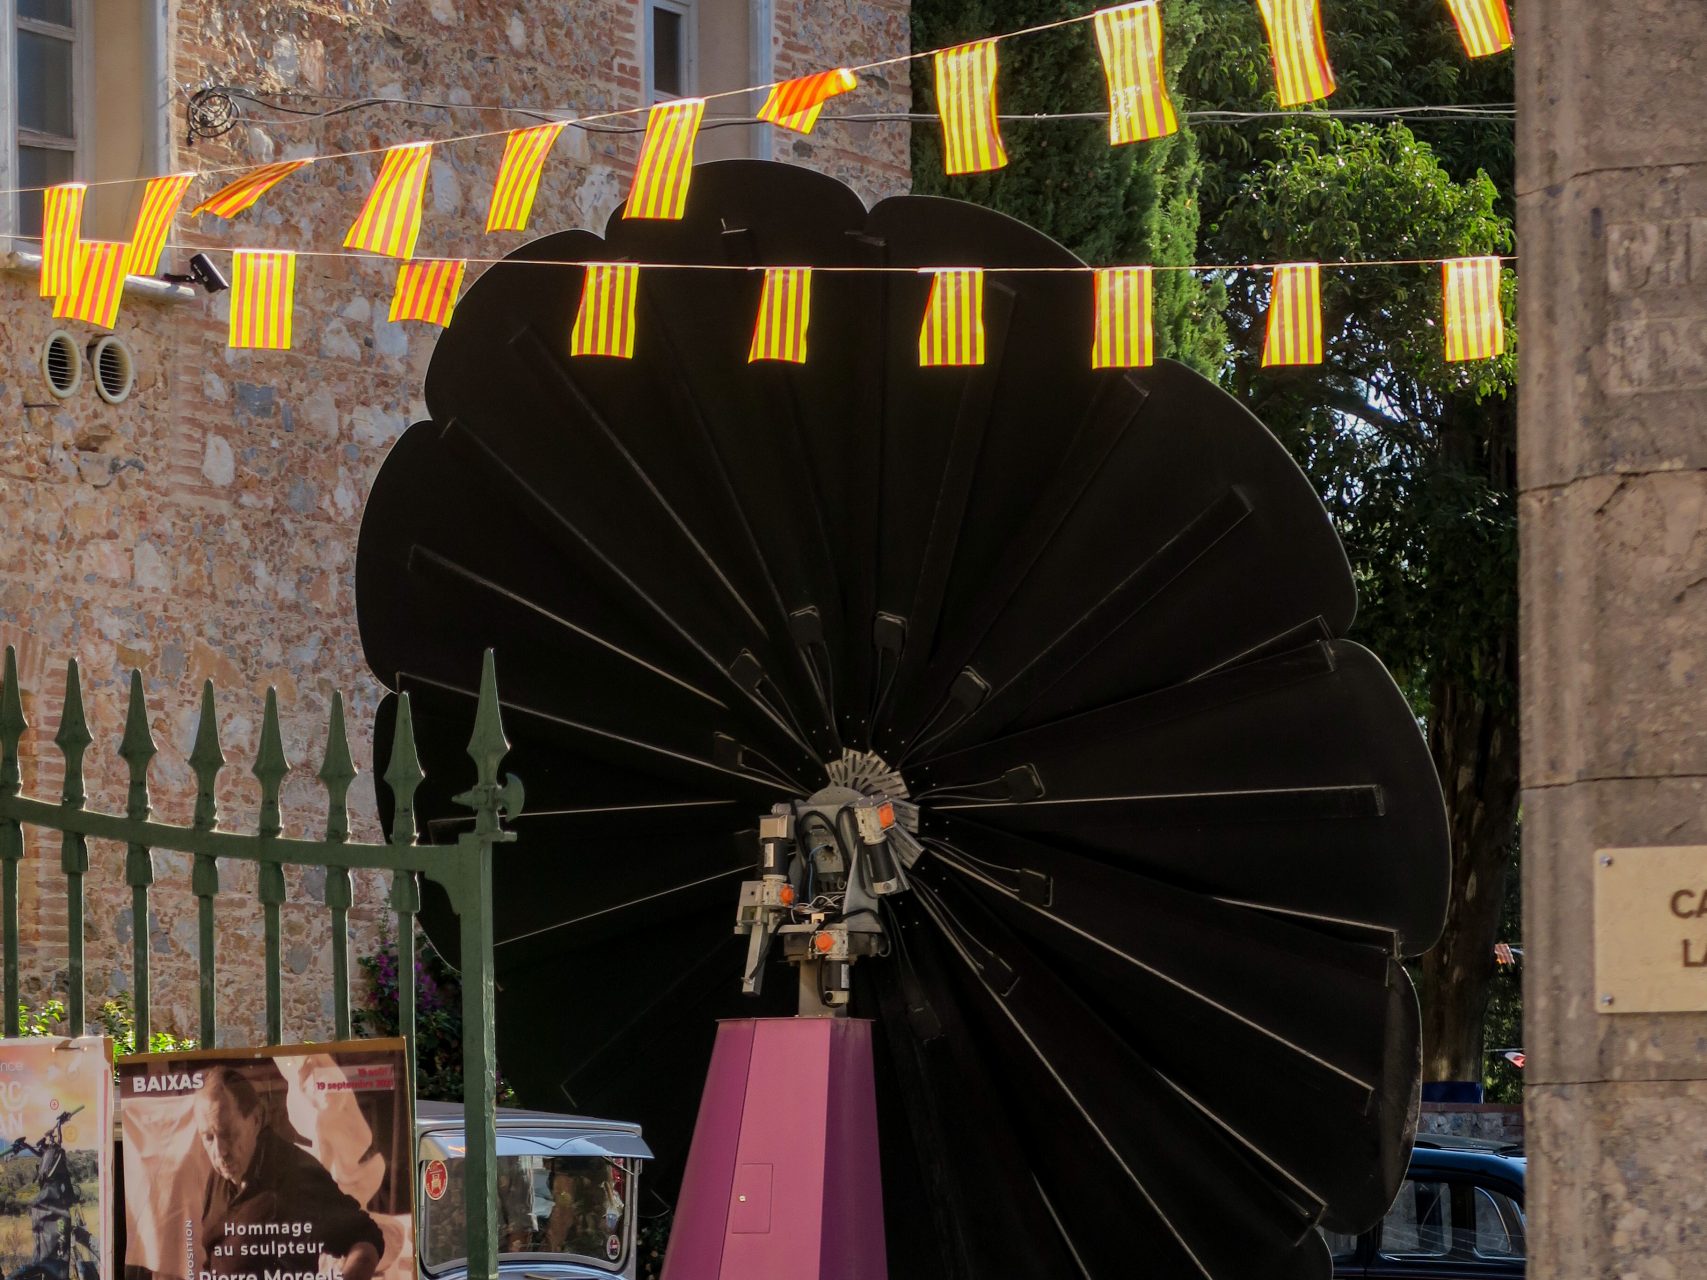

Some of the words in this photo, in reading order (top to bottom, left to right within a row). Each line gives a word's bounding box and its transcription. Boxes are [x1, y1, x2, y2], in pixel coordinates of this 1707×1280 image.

[1682, 938, 1707, 967] L
[132, 1073, 204, 1094] BAIXAS
[316, 1081, 325, 1090] 19
[328, 1080, 372, 1091] septembre
[223, 1222, 313, 1237] Hommage
[213, 1246, 234, 1257] au
[240, 1241, 325, 1258] sculpteur
